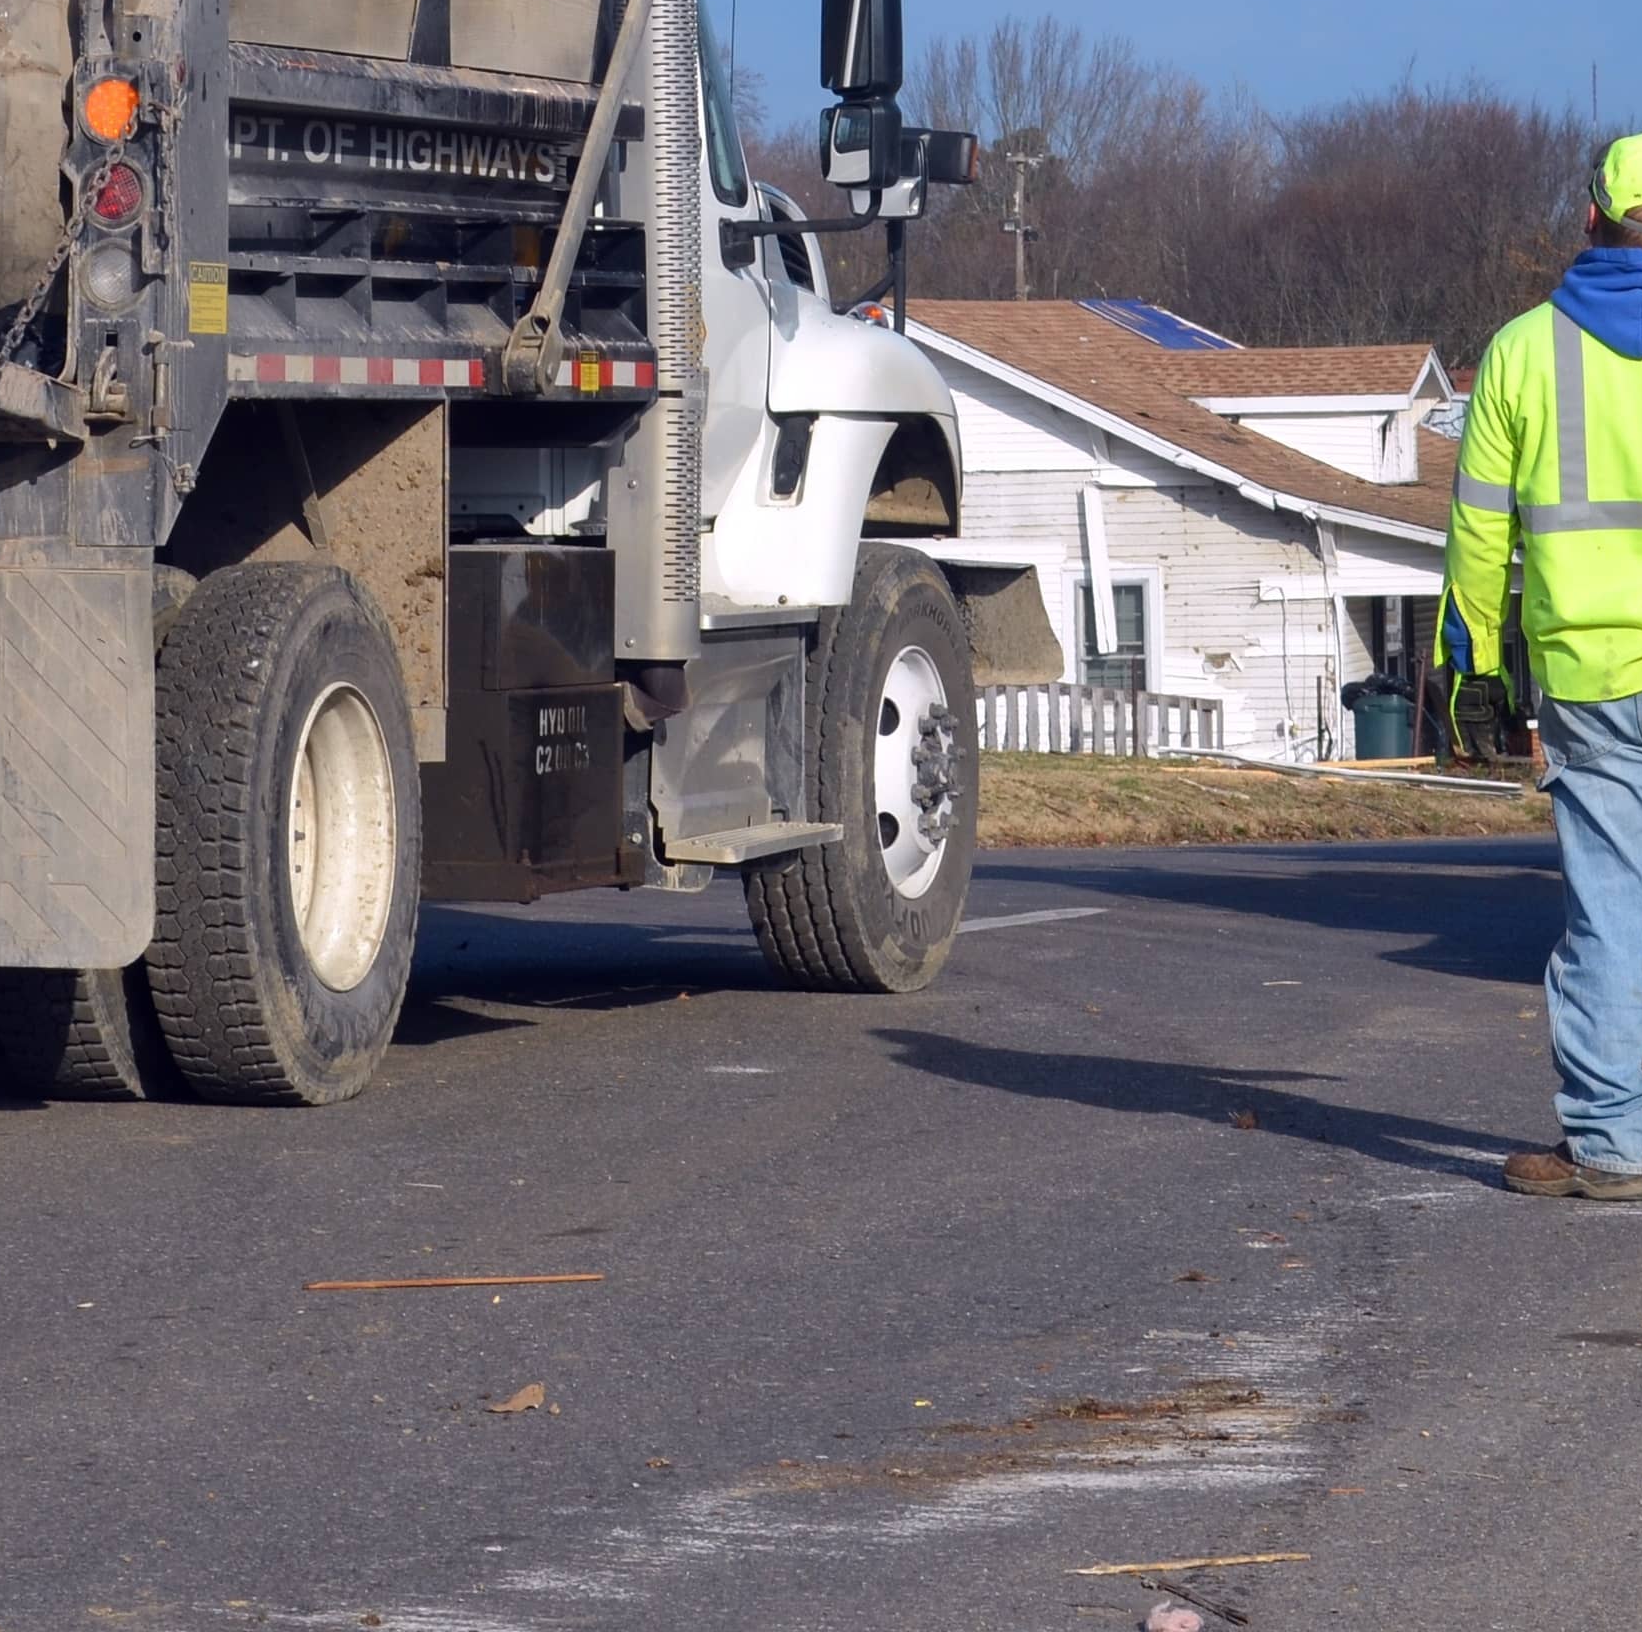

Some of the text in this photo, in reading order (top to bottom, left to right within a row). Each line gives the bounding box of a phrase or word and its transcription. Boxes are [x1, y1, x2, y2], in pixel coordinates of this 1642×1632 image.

[303, 120, 357, 165] OF
[368, 125, 556, 184] HIGHWAYS
[539, 708, 565, 737] HYD
[536, 745, 552, 775] C2
